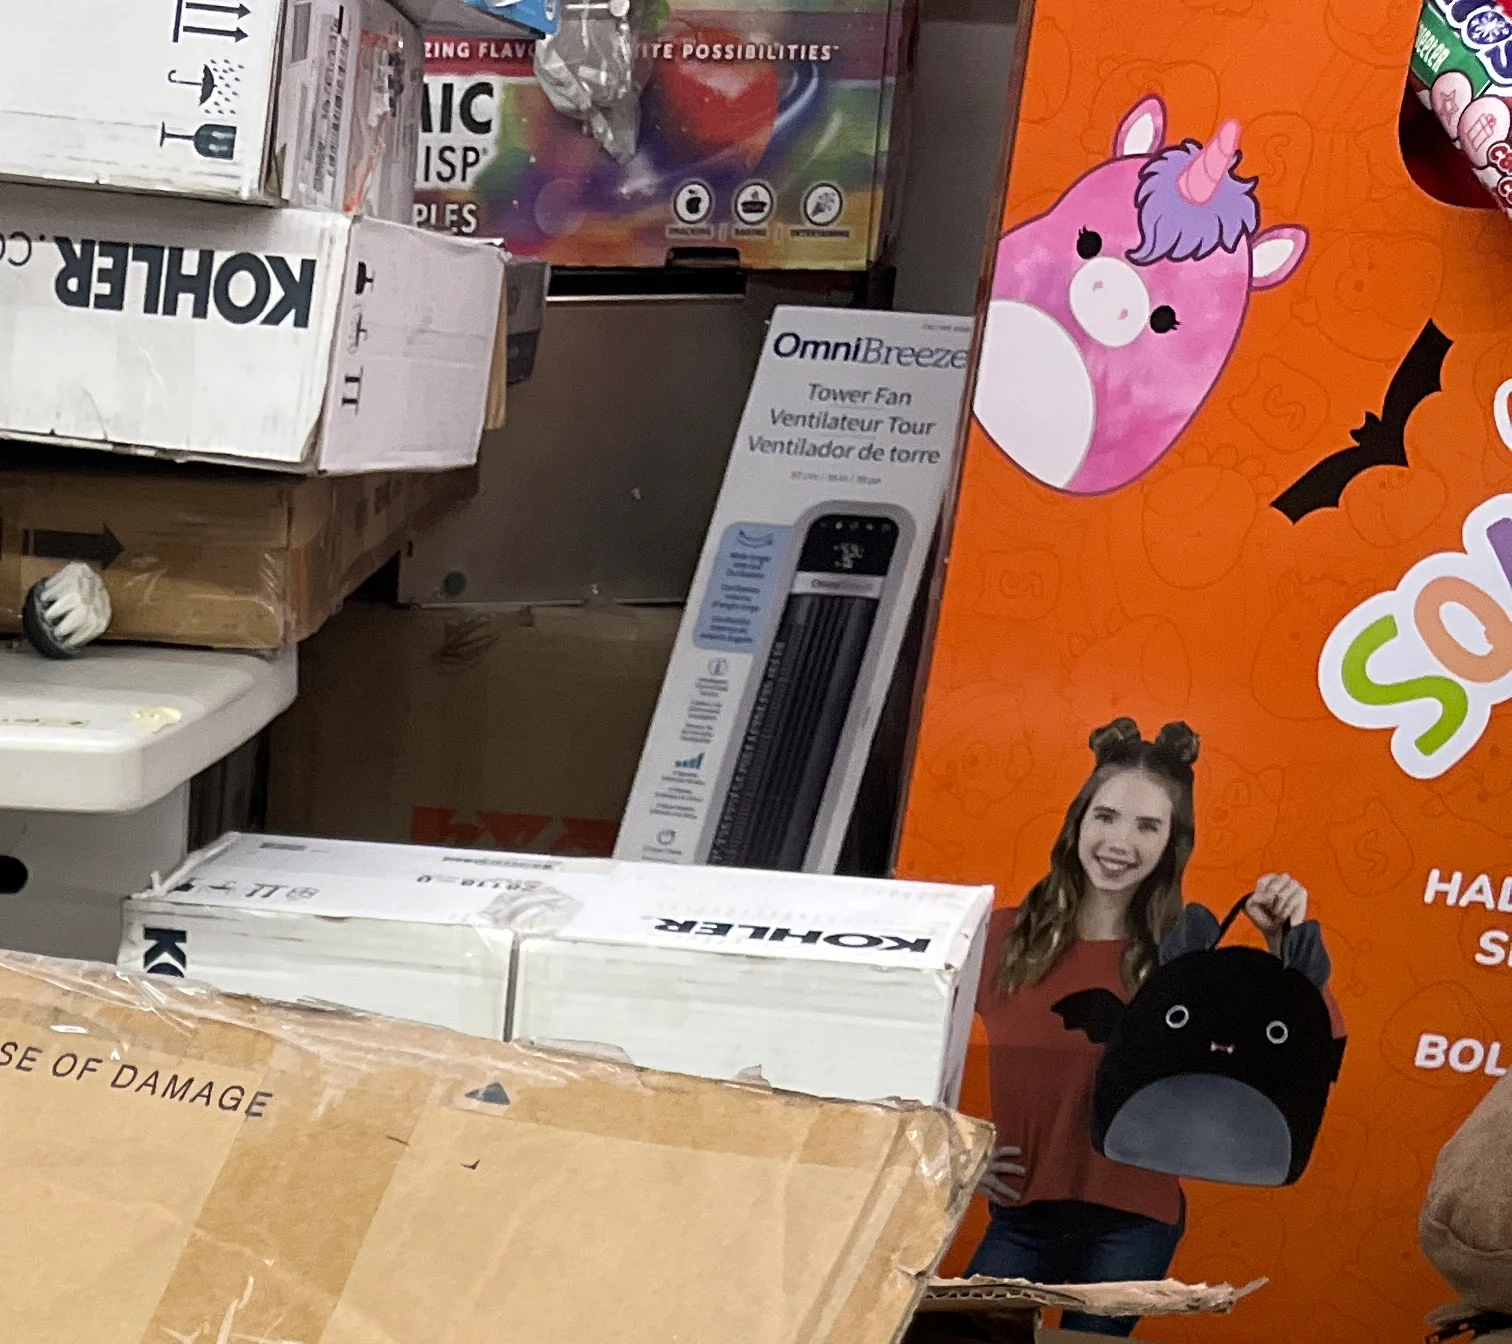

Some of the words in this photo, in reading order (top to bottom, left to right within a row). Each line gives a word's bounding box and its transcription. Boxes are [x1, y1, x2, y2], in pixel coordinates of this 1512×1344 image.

[423, 41, 470, 59] ZING
[640, 42, 673, 60] ITE
[423, 145, 481, 183] ISP
[413, 202, 479, 235] PLES
[773, 331, 968, 370] OmniBreeze
[808, 383, 872, 405] Tower
[874, 386, 913, 407] Fan
[770, 407, 884, 433] Ventilateur
[888, 415, 936, 436] Tour
[748, 434, 852, 460] Ventilador
[857, 442, 885, 462] de
[890, 446, 941, 464] torre
[654, 917, 932, 953] KOHLER
[1474, 929, 1512, 968] S
[51, 1052, 104, 1082] OF
[110, 1063, 274, 1118] DAMAGE
